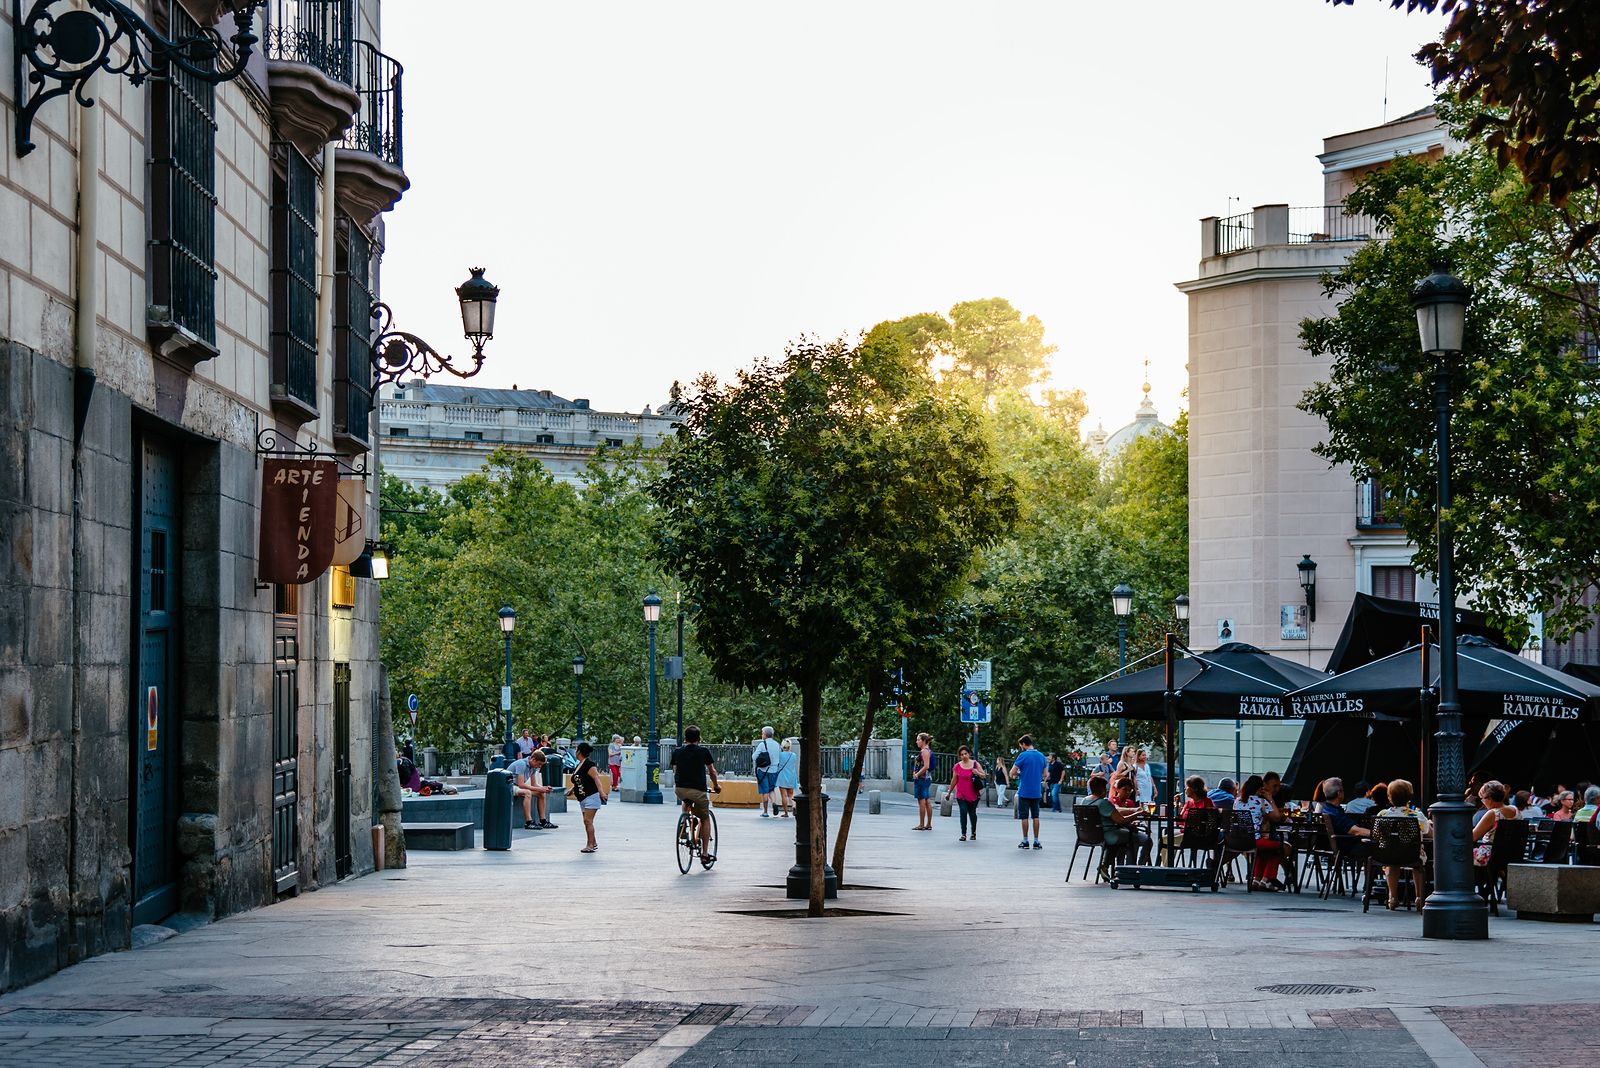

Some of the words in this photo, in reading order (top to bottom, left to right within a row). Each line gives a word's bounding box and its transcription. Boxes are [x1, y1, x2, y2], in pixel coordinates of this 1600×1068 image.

[274, 468, 324, 486] ARTE
[1303, 693, 1334, 702] TABERNA
[1514, 694, 1550, 704] TABERNA
[1064, 702, 1124, 716] RAMALES
[1294, 698, 1364, 714] RAMALES
[1502, 702, 1580, 720] RAMALES
